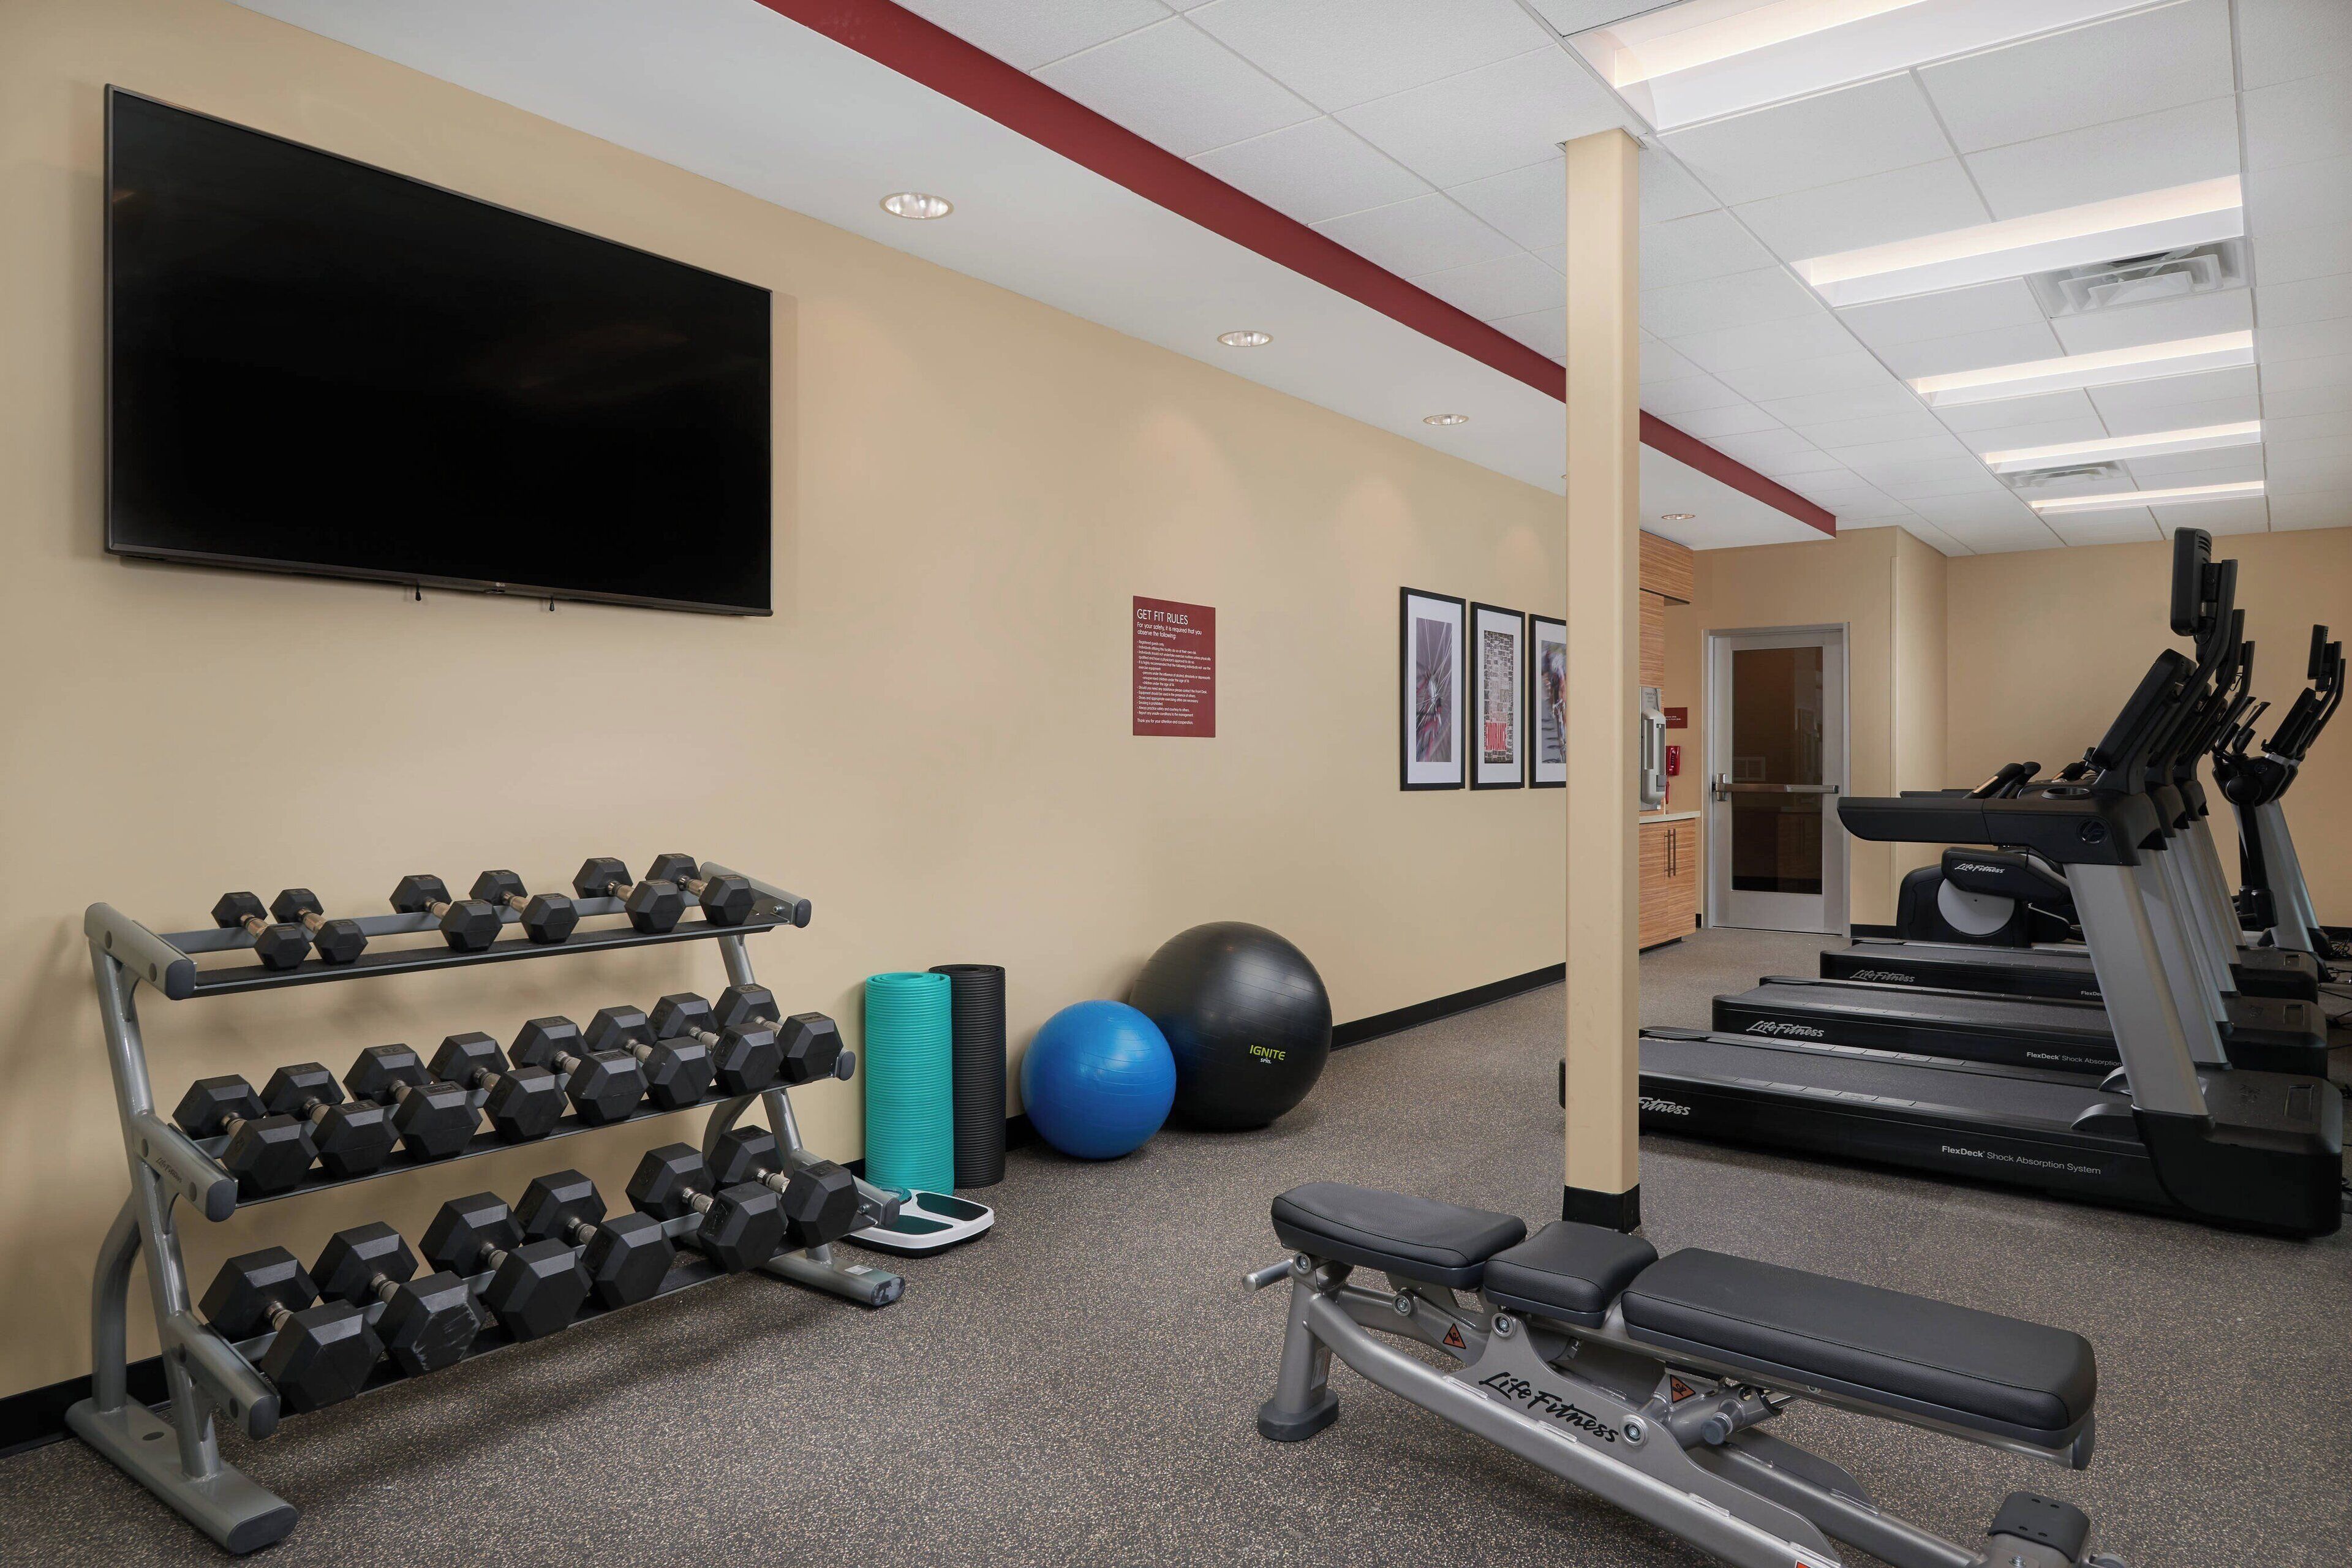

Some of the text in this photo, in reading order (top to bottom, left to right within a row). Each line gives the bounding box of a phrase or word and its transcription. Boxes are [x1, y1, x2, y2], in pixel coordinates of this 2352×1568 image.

[1137, 608, 1188, 625] GET FIT RULES
[1972, 865, 2005, 873] Fitness
[1849, 969, 1915, 982] Life Fitness
[1746, 1020, 1826, 1037] Life Fitness
[1250, 1044, 1286, 1061] IGNITE
[2084, 1058, 2121, 1066] Absorption
[1987, 1152, 2014, 1162] Shock
[2016, 1156, 2064, 1169] Absorption
[2067, 1163, 2101, 1174] System
[1478, 1372, 1619, 1443] Life Fitness
